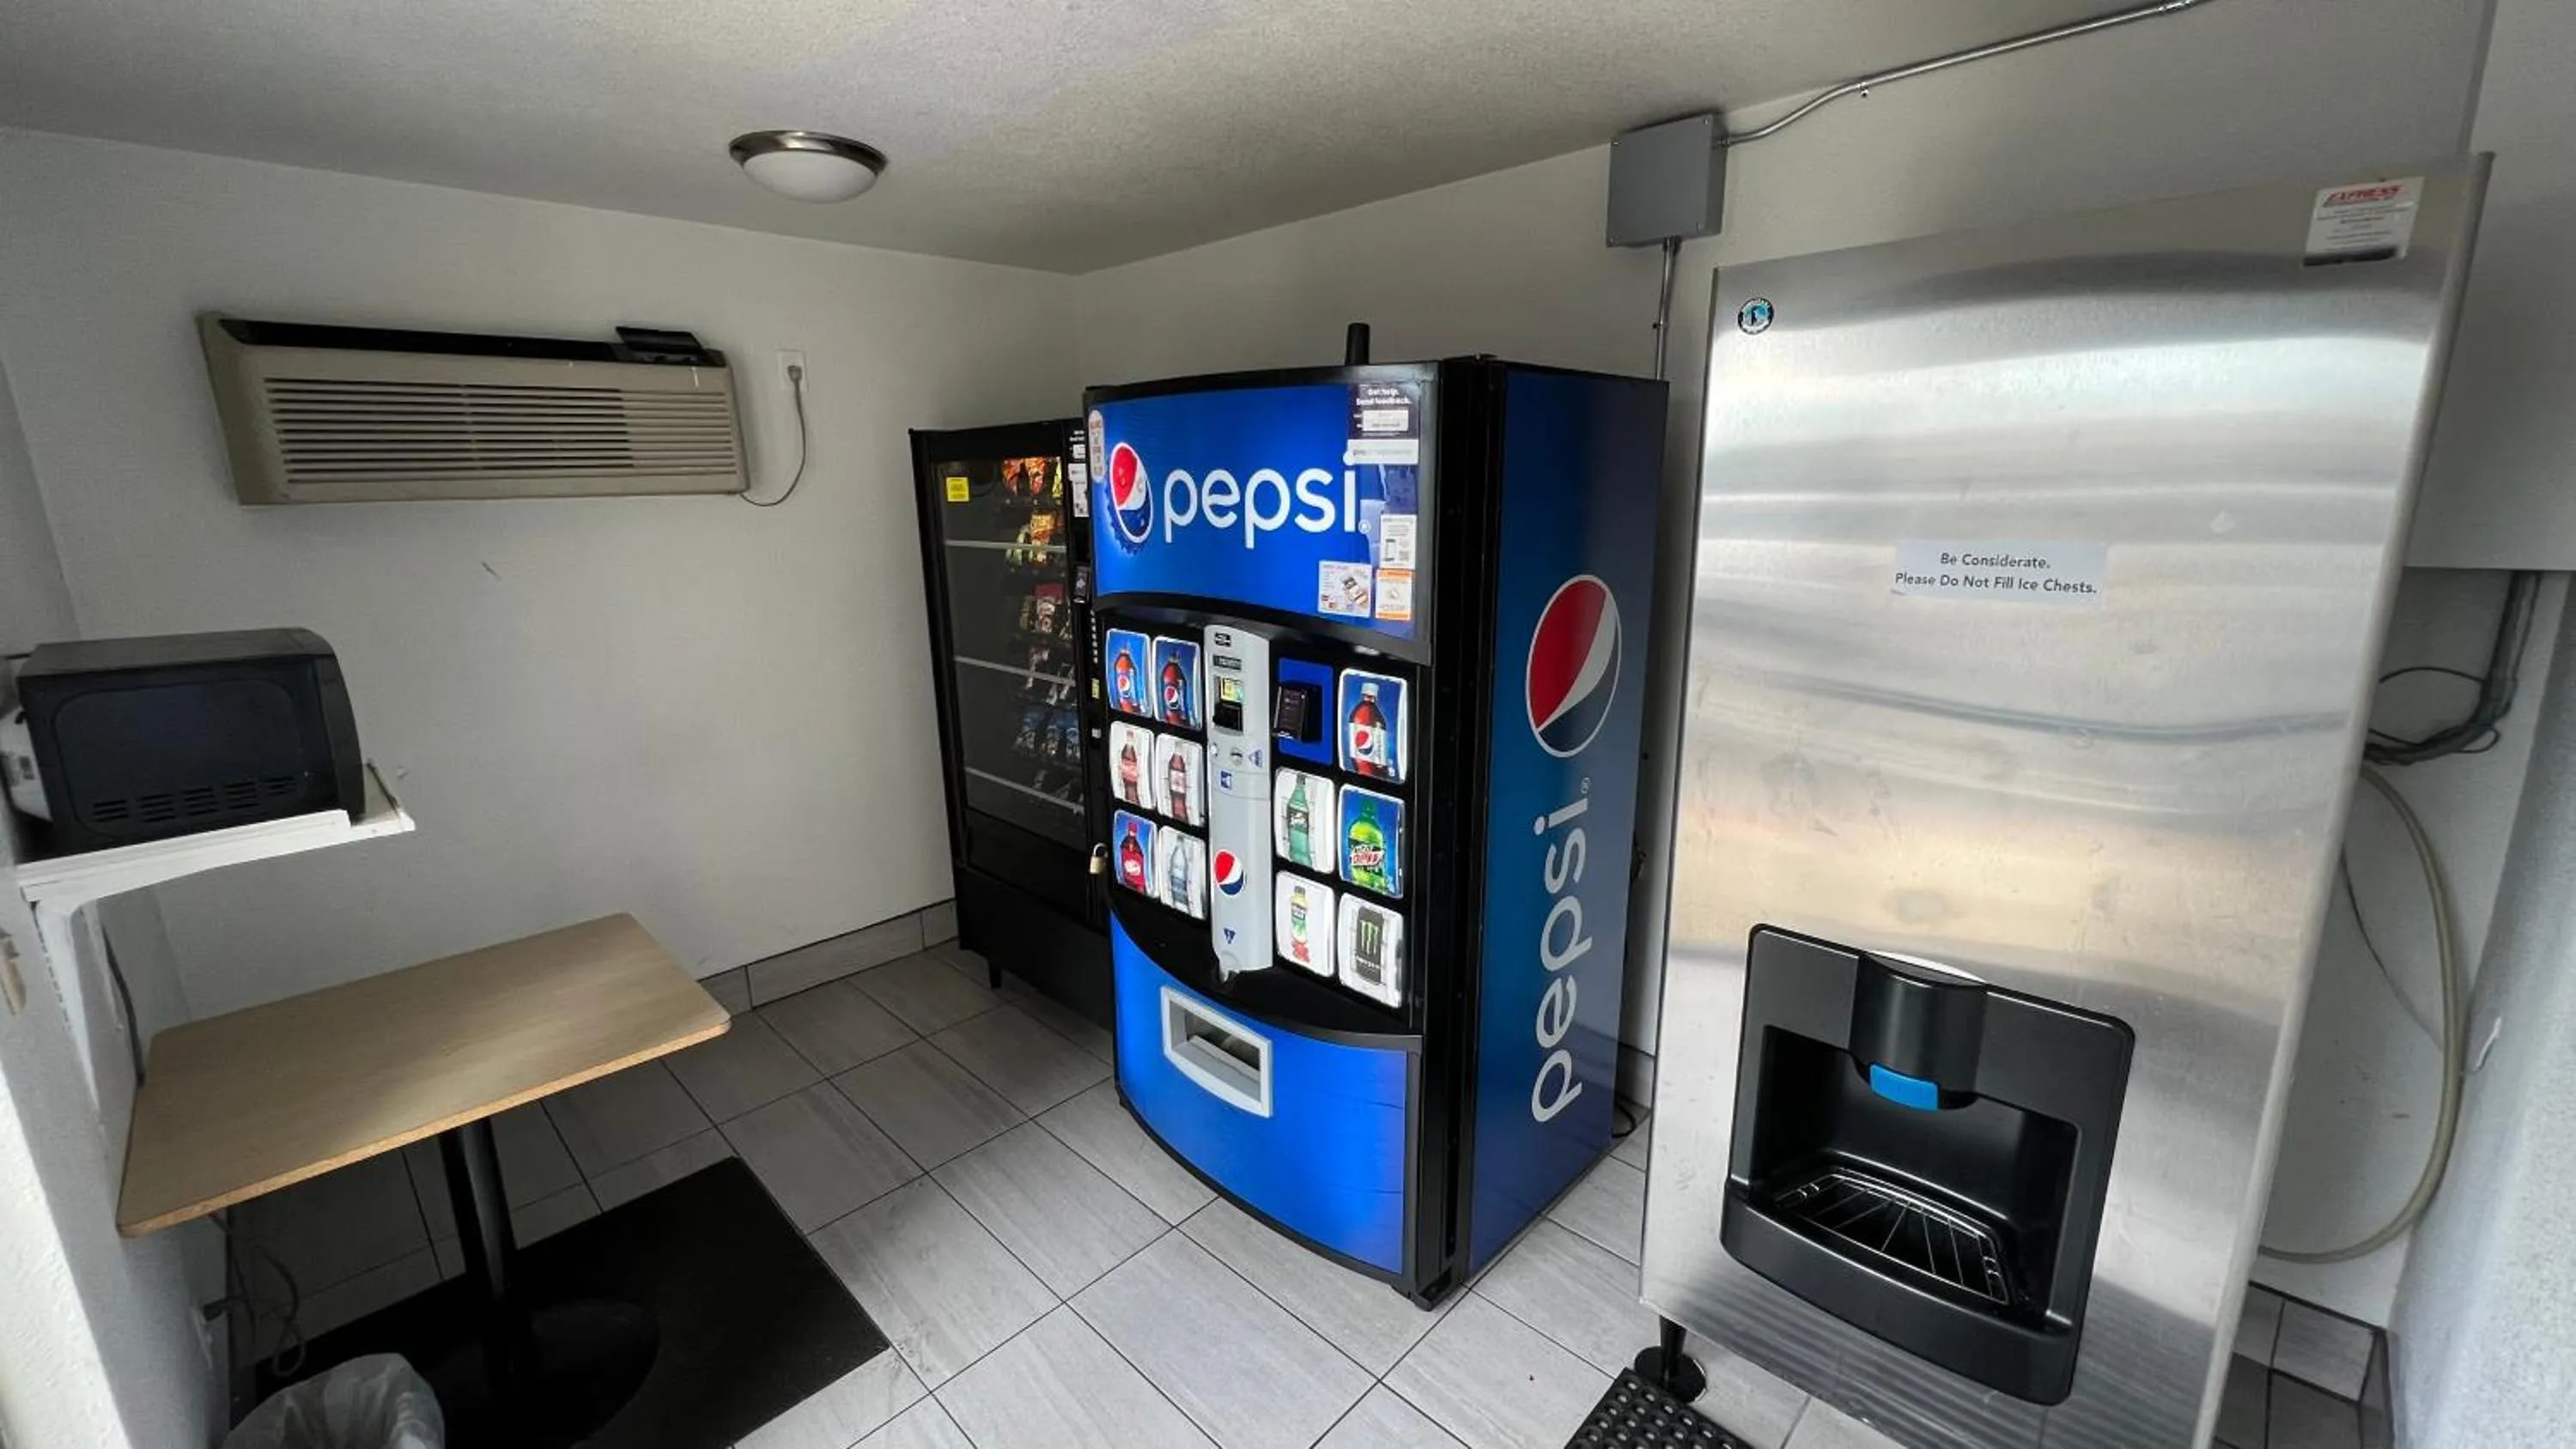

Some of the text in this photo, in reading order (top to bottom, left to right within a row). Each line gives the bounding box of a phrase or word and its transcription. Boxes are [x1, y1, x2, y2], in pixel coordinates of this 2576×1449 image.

[1163, 452, 1356, 549] pepsi
[1895, 571, 2098, 594] Please Do Not Fill Ice Chests.
[1941, 552, 2050, 569] Be Considerate.
[1531, 797, 1594, 1122] pepsi
